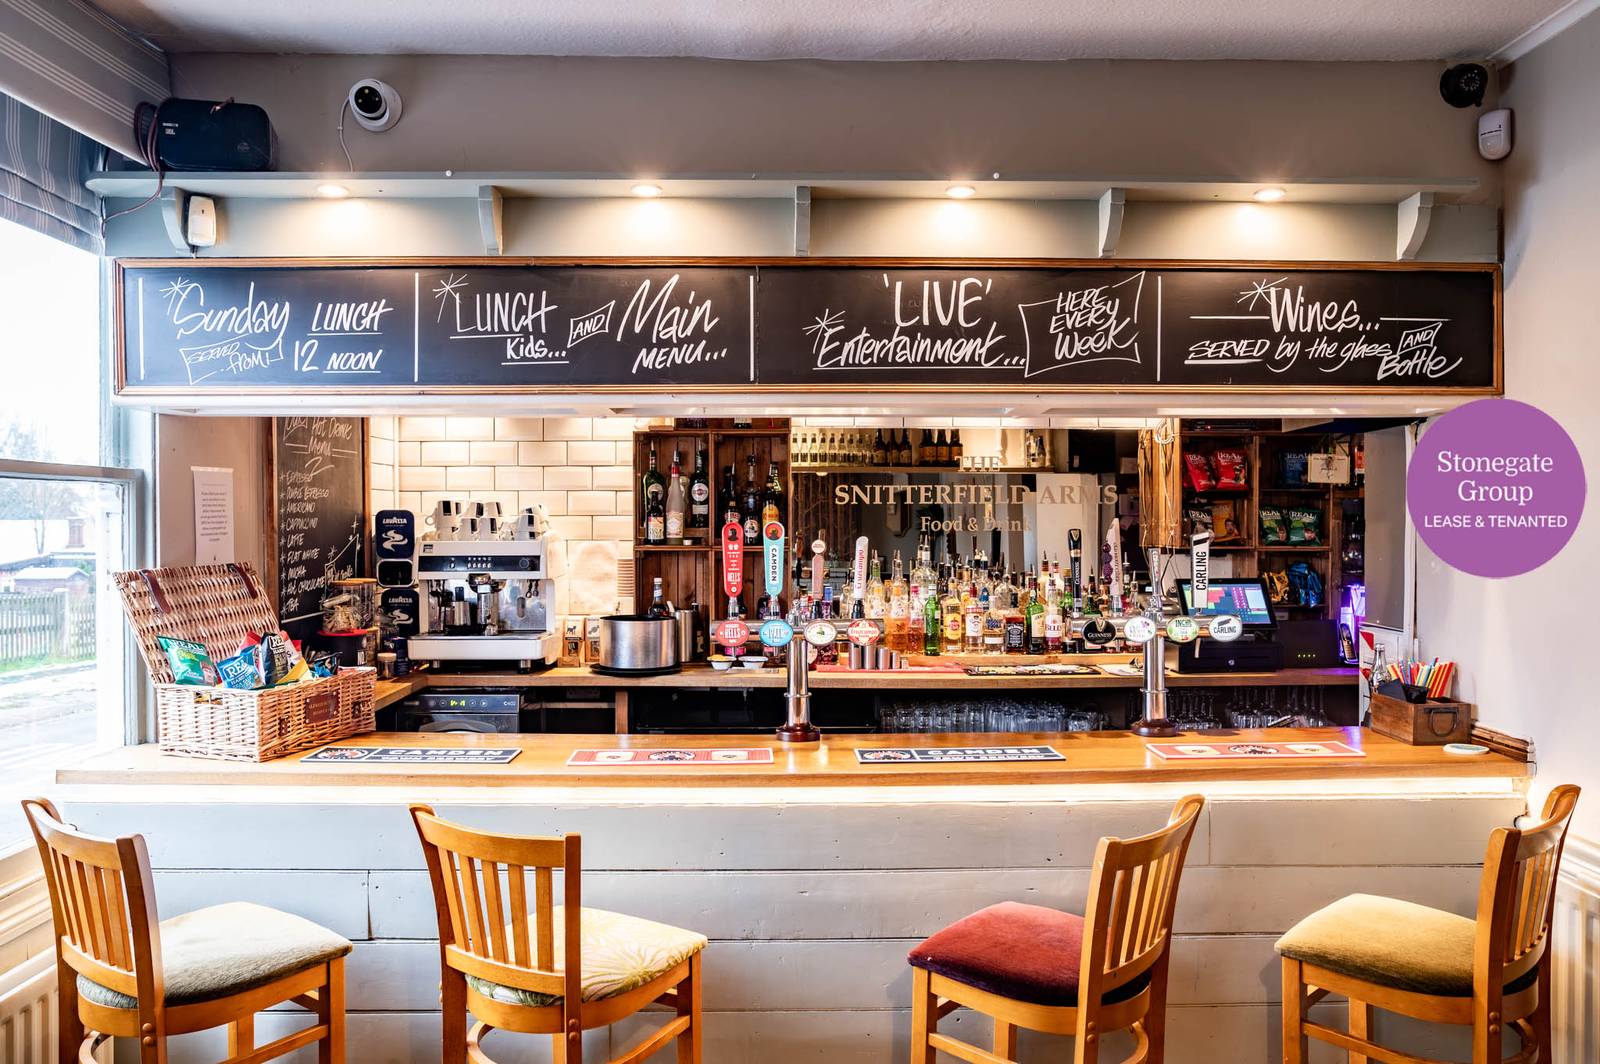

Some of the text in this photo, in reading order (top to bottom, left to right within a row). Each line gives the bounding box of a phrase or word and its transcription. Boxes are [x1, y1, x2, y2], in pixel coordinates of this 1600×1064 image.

[456, 290, 558, 333] LUNCH
[617, 274, 720, 343] Main
[883, 273, 992, 328] 'LIVE'
[1056, 285, 1111, 313] HERE
[1270, 285, 1379, 333] Wines...
[172, 282, 393, 350] Sunday LUNCH
[573, 314, 604, 340] AND
[186, 341, 240, 364] SERVED
[506, 338, 566, 360] Kids...
[1188, 335, 1393, 372] SERVED by the glass
[1404, 330, 1432, 348] AND
[294, 340, 382, 371] 12 NOON
[632, 340, 727, 374] MENU...
[1377, 347, 1463, 381] Bottle
[955, 455, 1001, 472] THE
[835, 484, 1118, 505] SNITTERFIELD ARMS
[383, 516, 407, 524] LAVAZZA
[920, 516, 963, 532] Food
[967, 517, 979, 531] &
[1195, 551, 1207, 591] CARLING
[1213, 626, 1237, 634] CARLING
